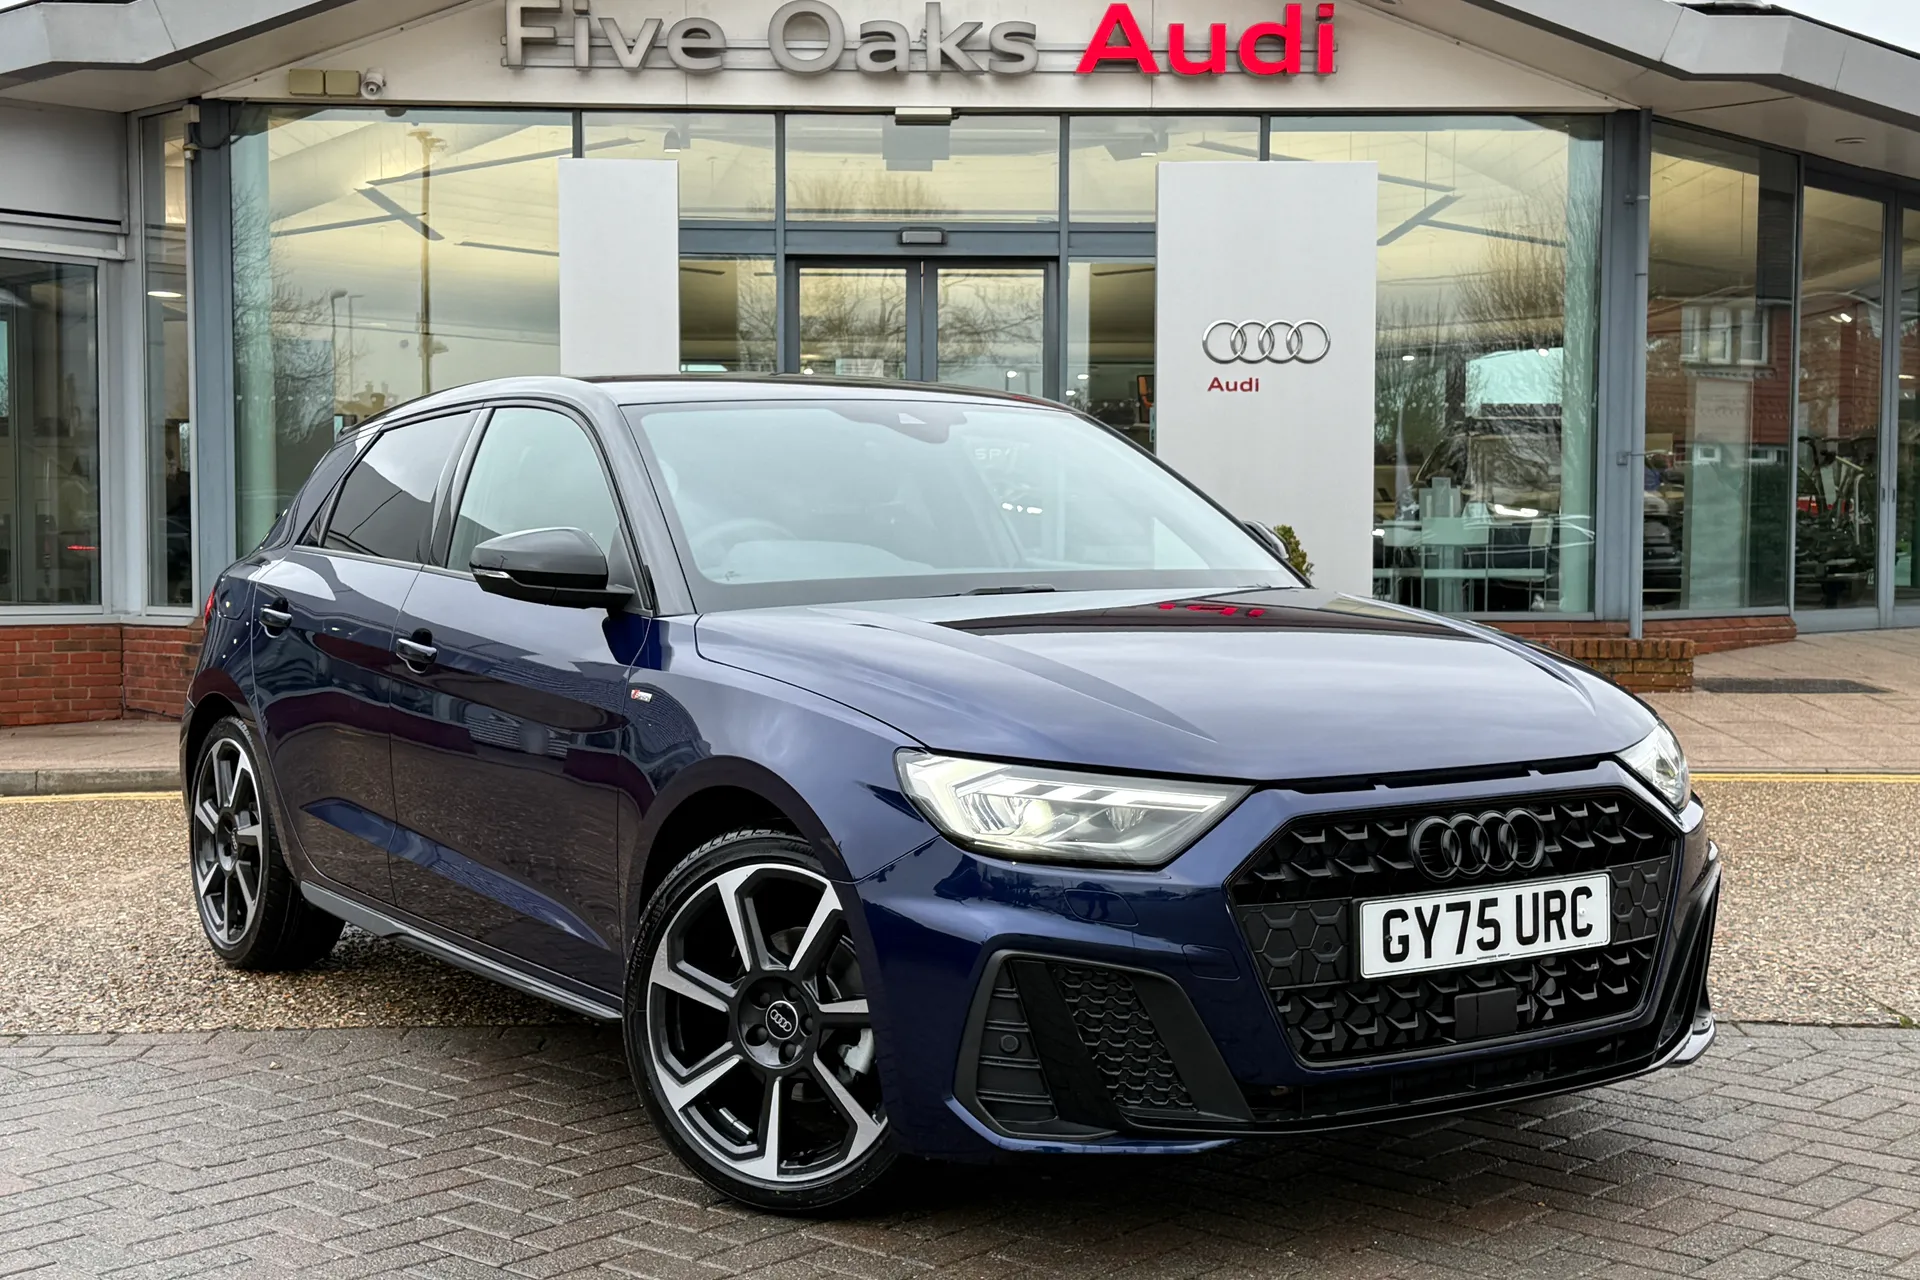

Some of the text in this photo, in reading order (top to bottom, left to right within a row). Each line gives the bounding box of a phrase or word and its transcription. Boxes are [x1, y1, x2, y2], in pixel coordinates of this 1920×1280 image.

[505, 0, 1335, 76] Five Oaks Audi
[1207, 376, 1260, 393] Audi
[1382, 886, 1594, 963] GY75 URC
